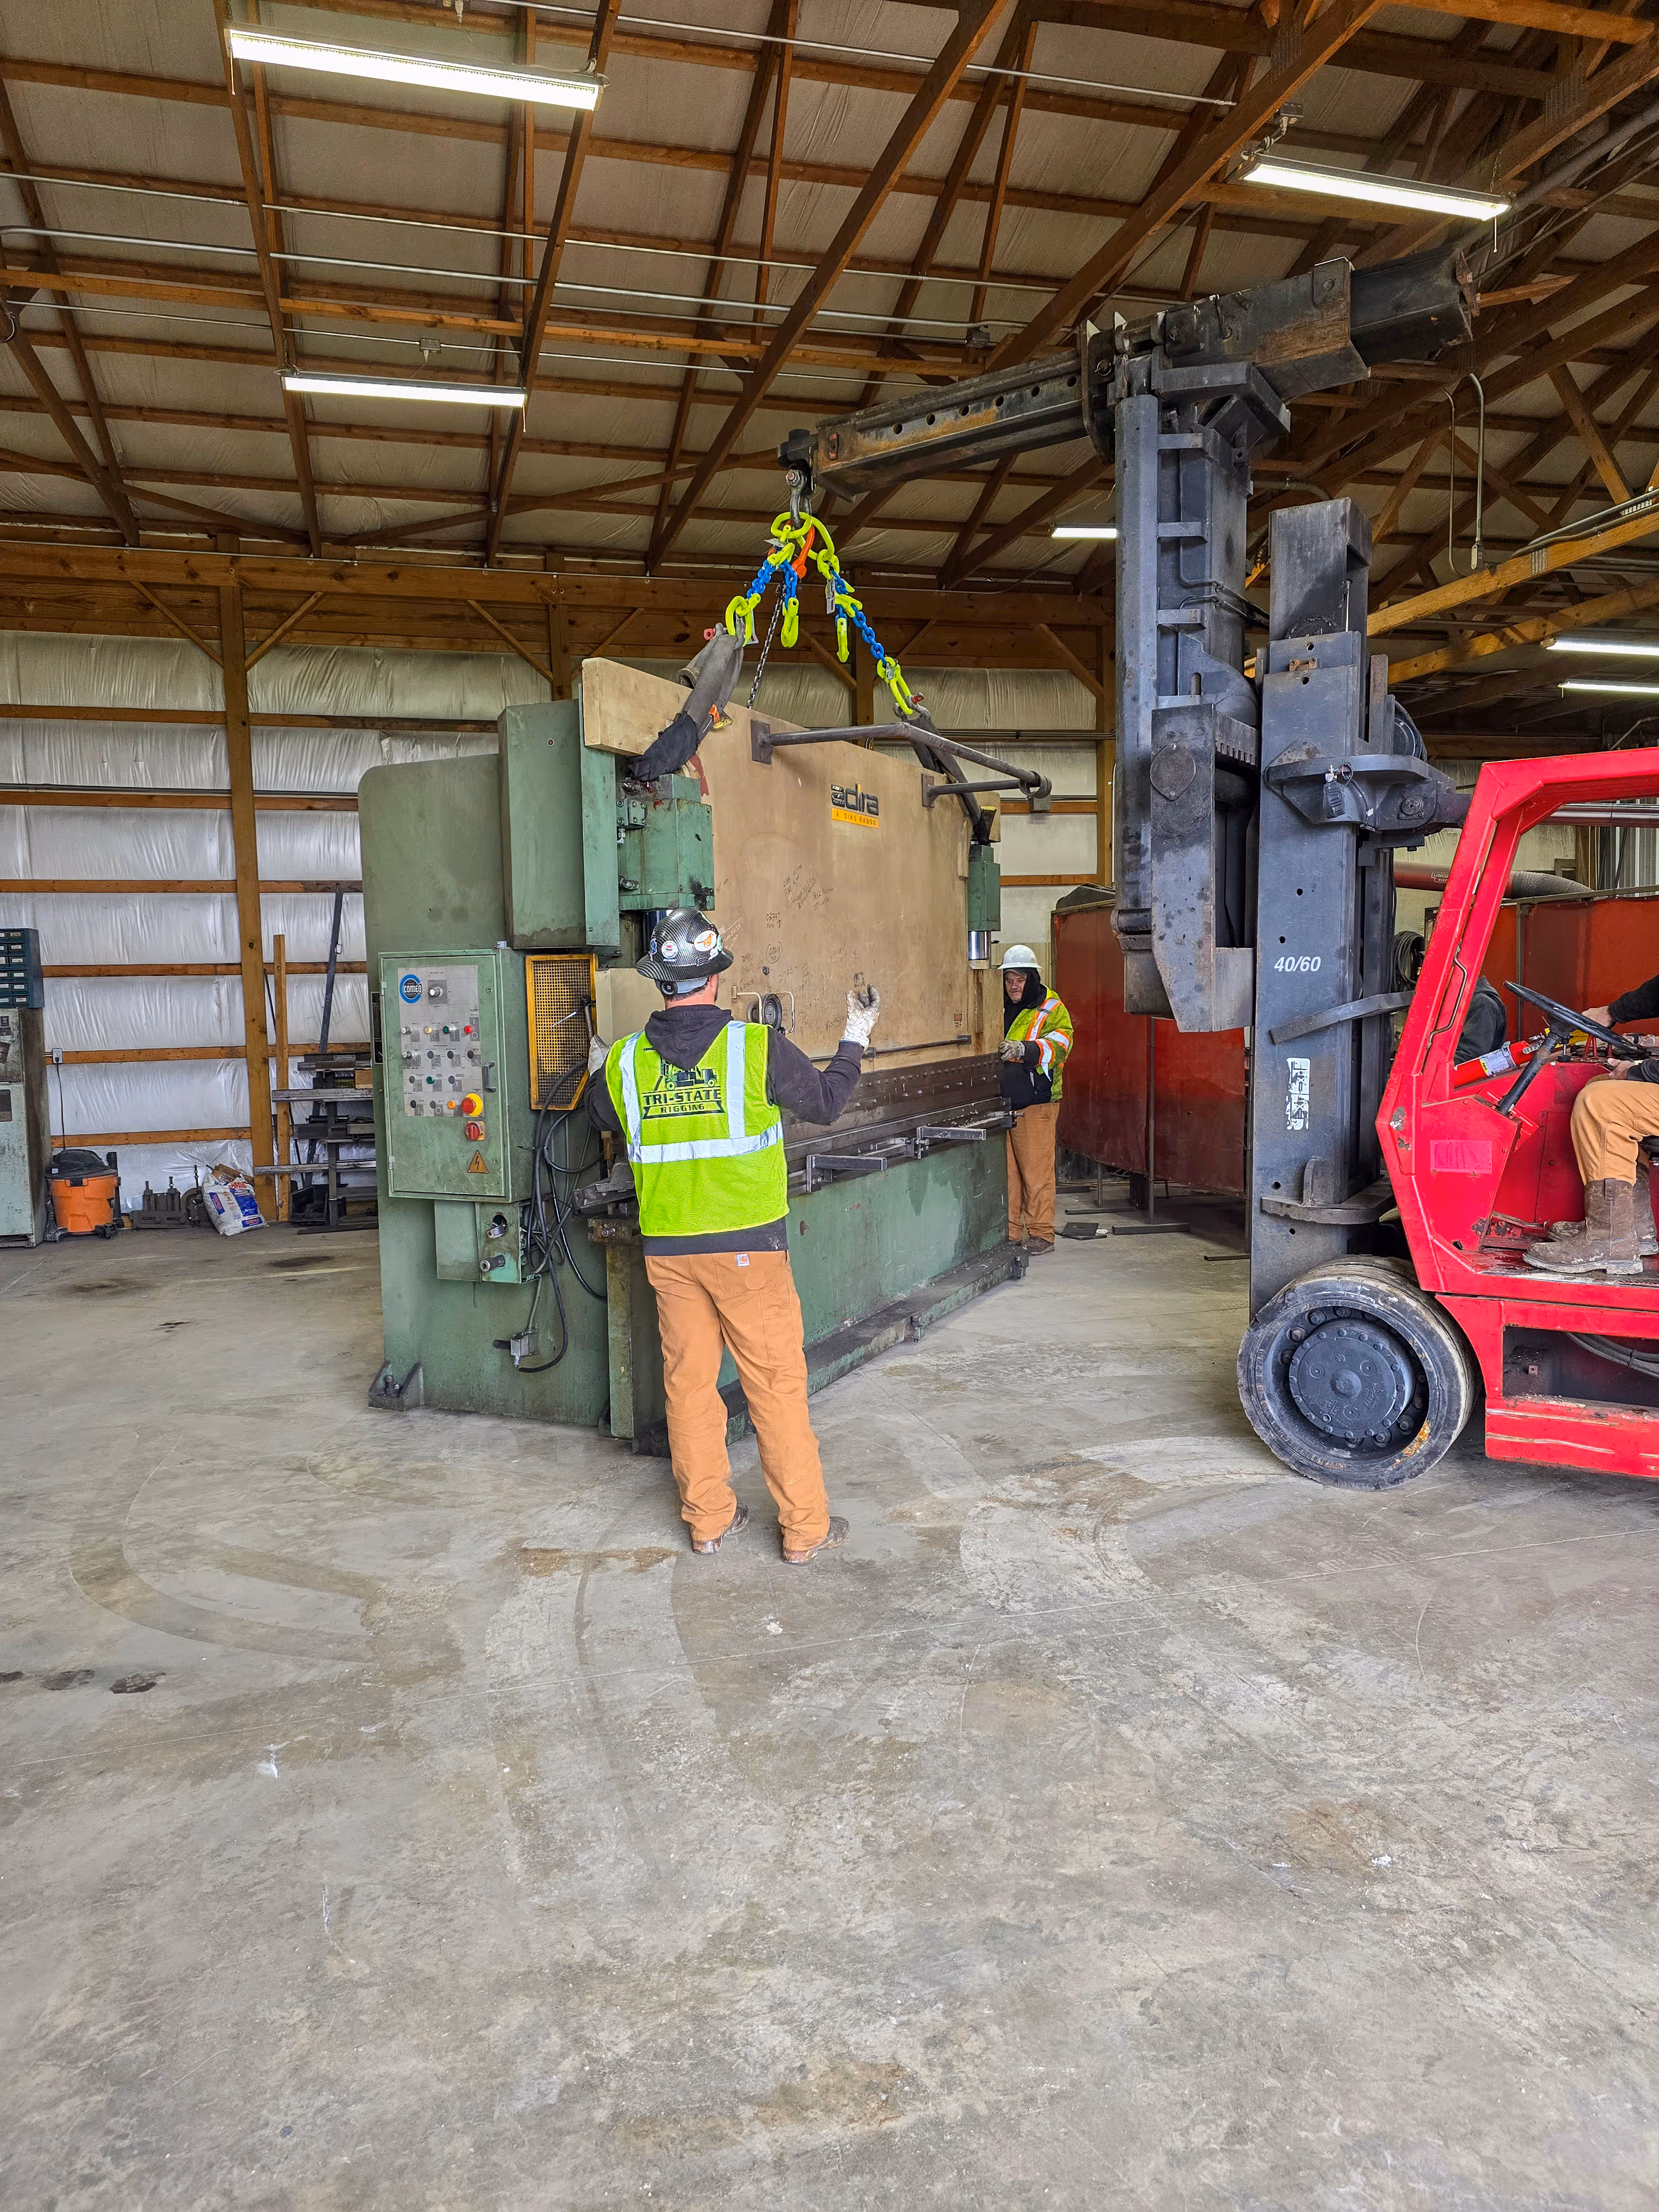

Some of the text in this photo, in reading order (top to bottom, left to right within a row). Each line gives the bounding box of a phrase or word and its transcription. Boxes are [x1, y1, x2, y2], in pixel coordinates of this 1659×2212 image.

[831, 783, 879, 816] adira
[844, 813, 857, 821] DIAS
[859, 816, 876, 826] RAMOS
[1274, 956, 1321, 972] 40/60
[404, 984, 422, 994] COMEQ
[643, 1089, 721, 1105] TRI-STATE
[660, 1104, 705, 1113] RIGGING
